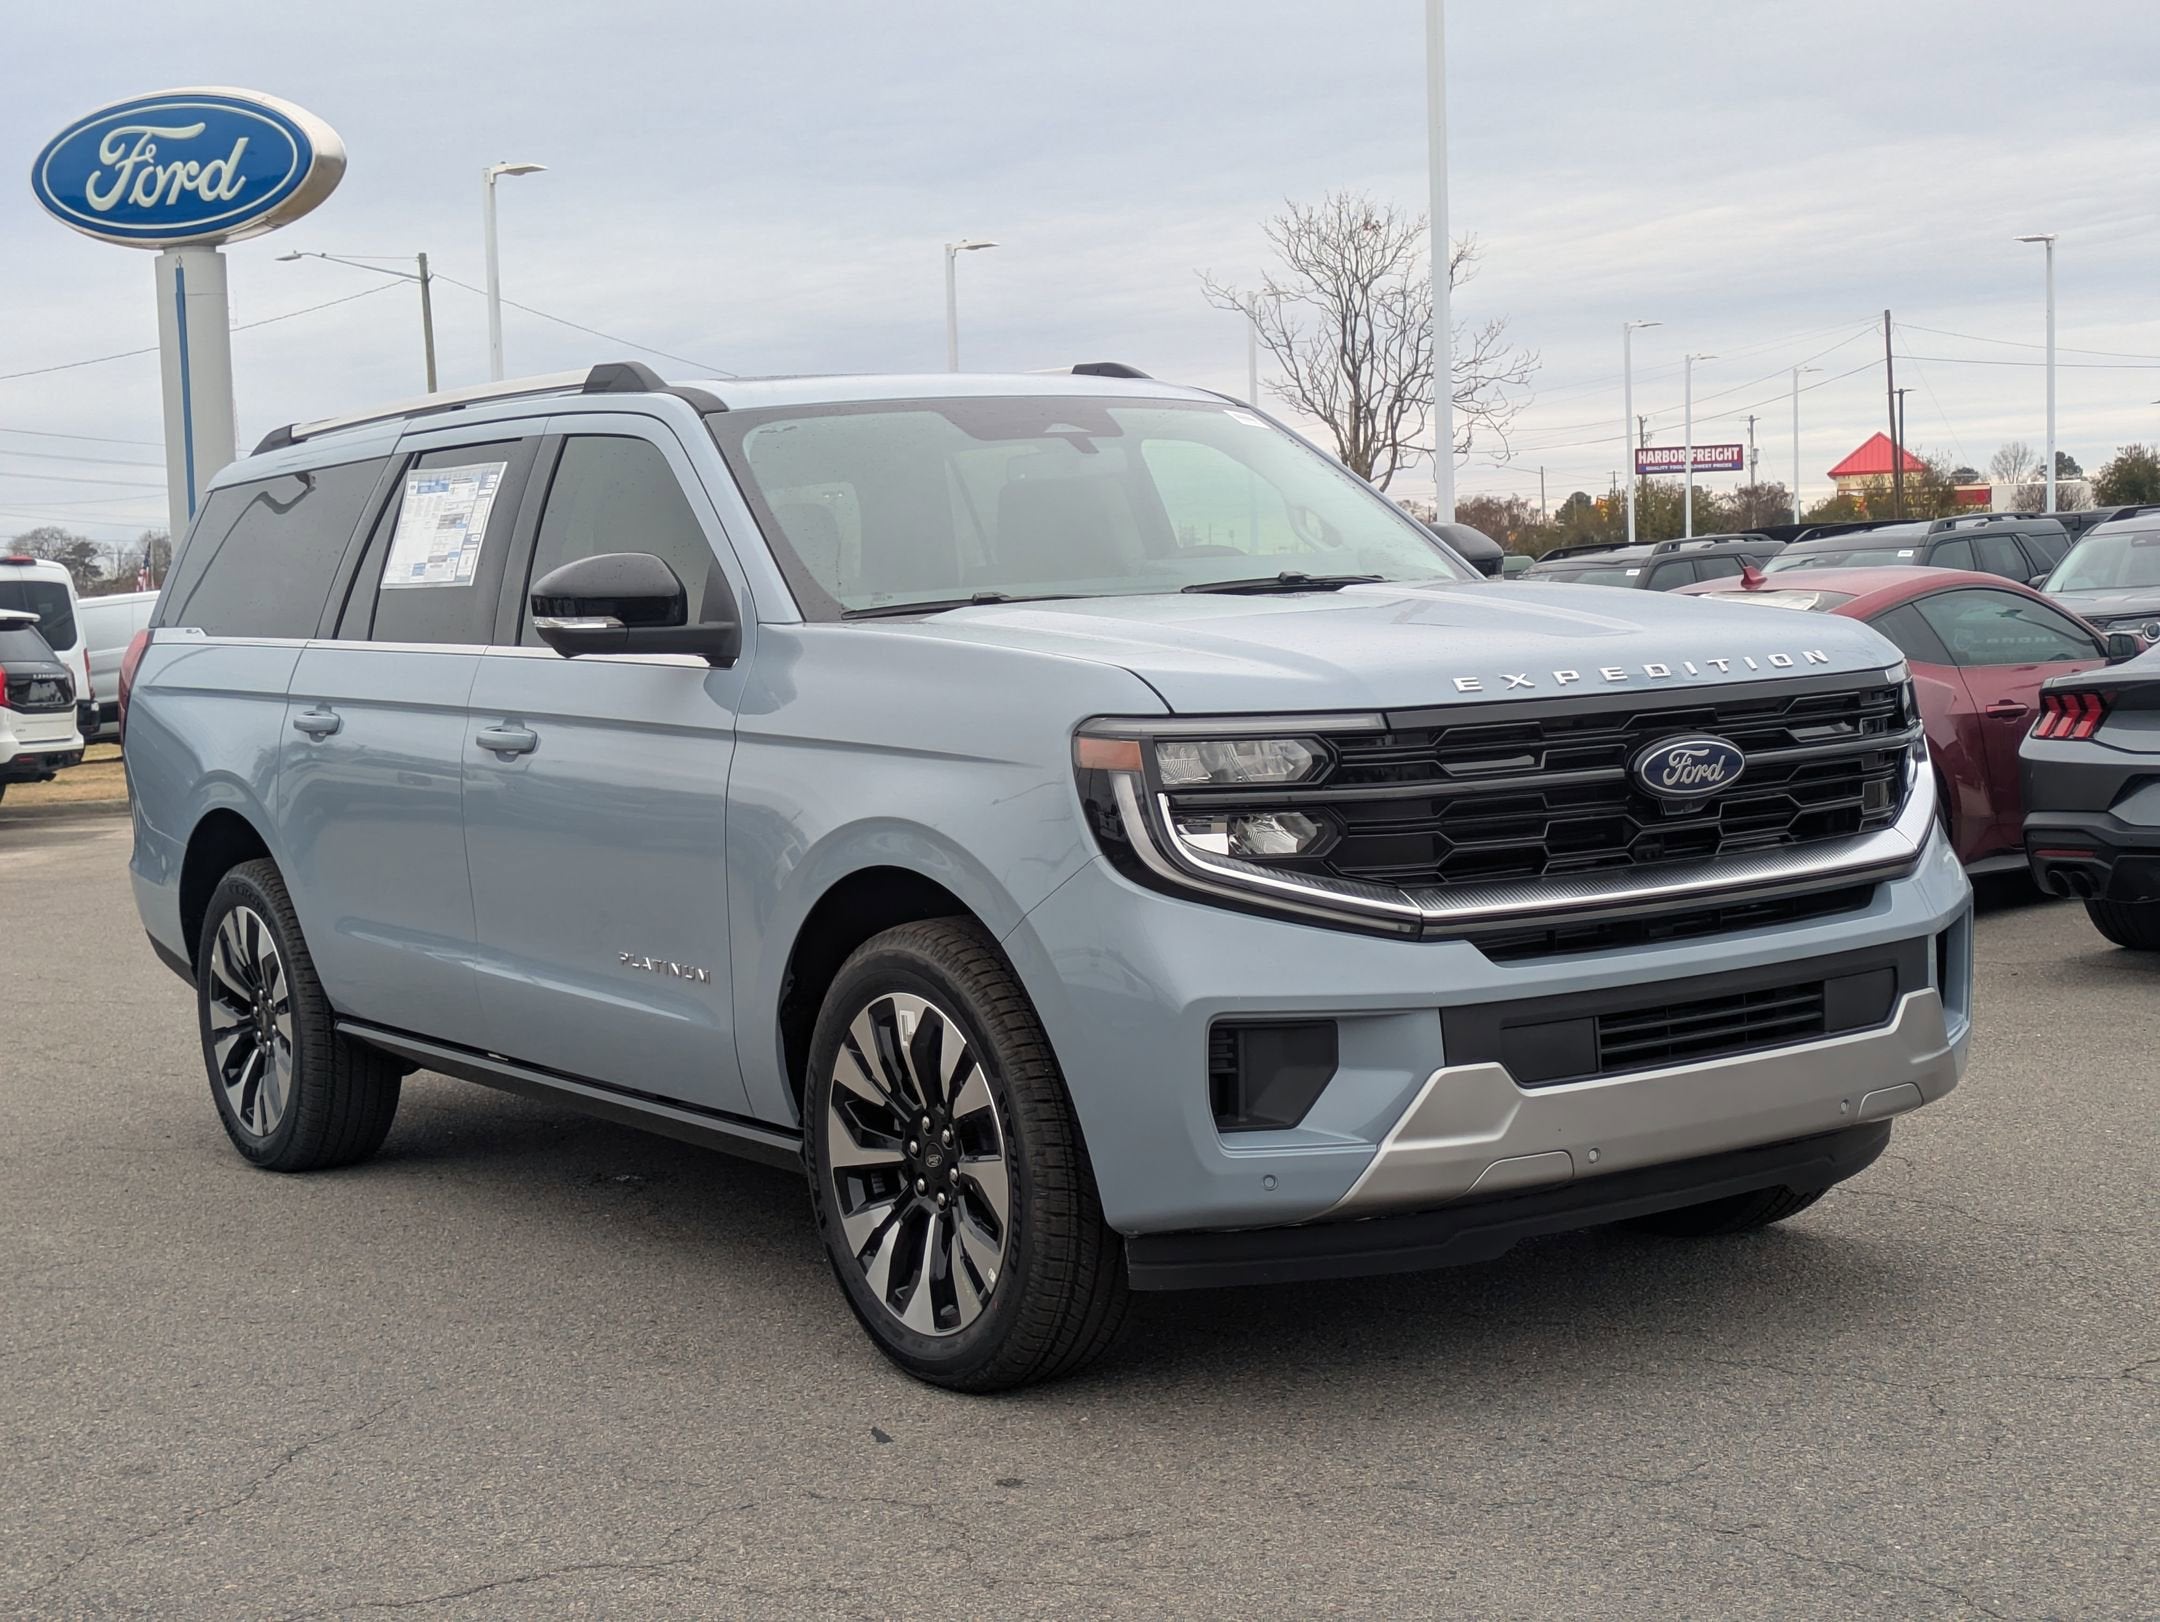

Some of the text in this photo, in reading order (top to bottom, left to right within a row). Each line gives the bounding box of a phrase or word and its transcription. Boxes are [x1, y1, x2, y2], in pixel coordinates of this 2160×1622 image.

[85, 121, 249, 212] Ford
[1638, 447, 1740, 465] HARBOR FREIGHT
[1452, 649, 1829, 692] EXPEDITION
[1663, 748, 1726, 786] Ford
[619, 951, 711, 984] PLATINUM
